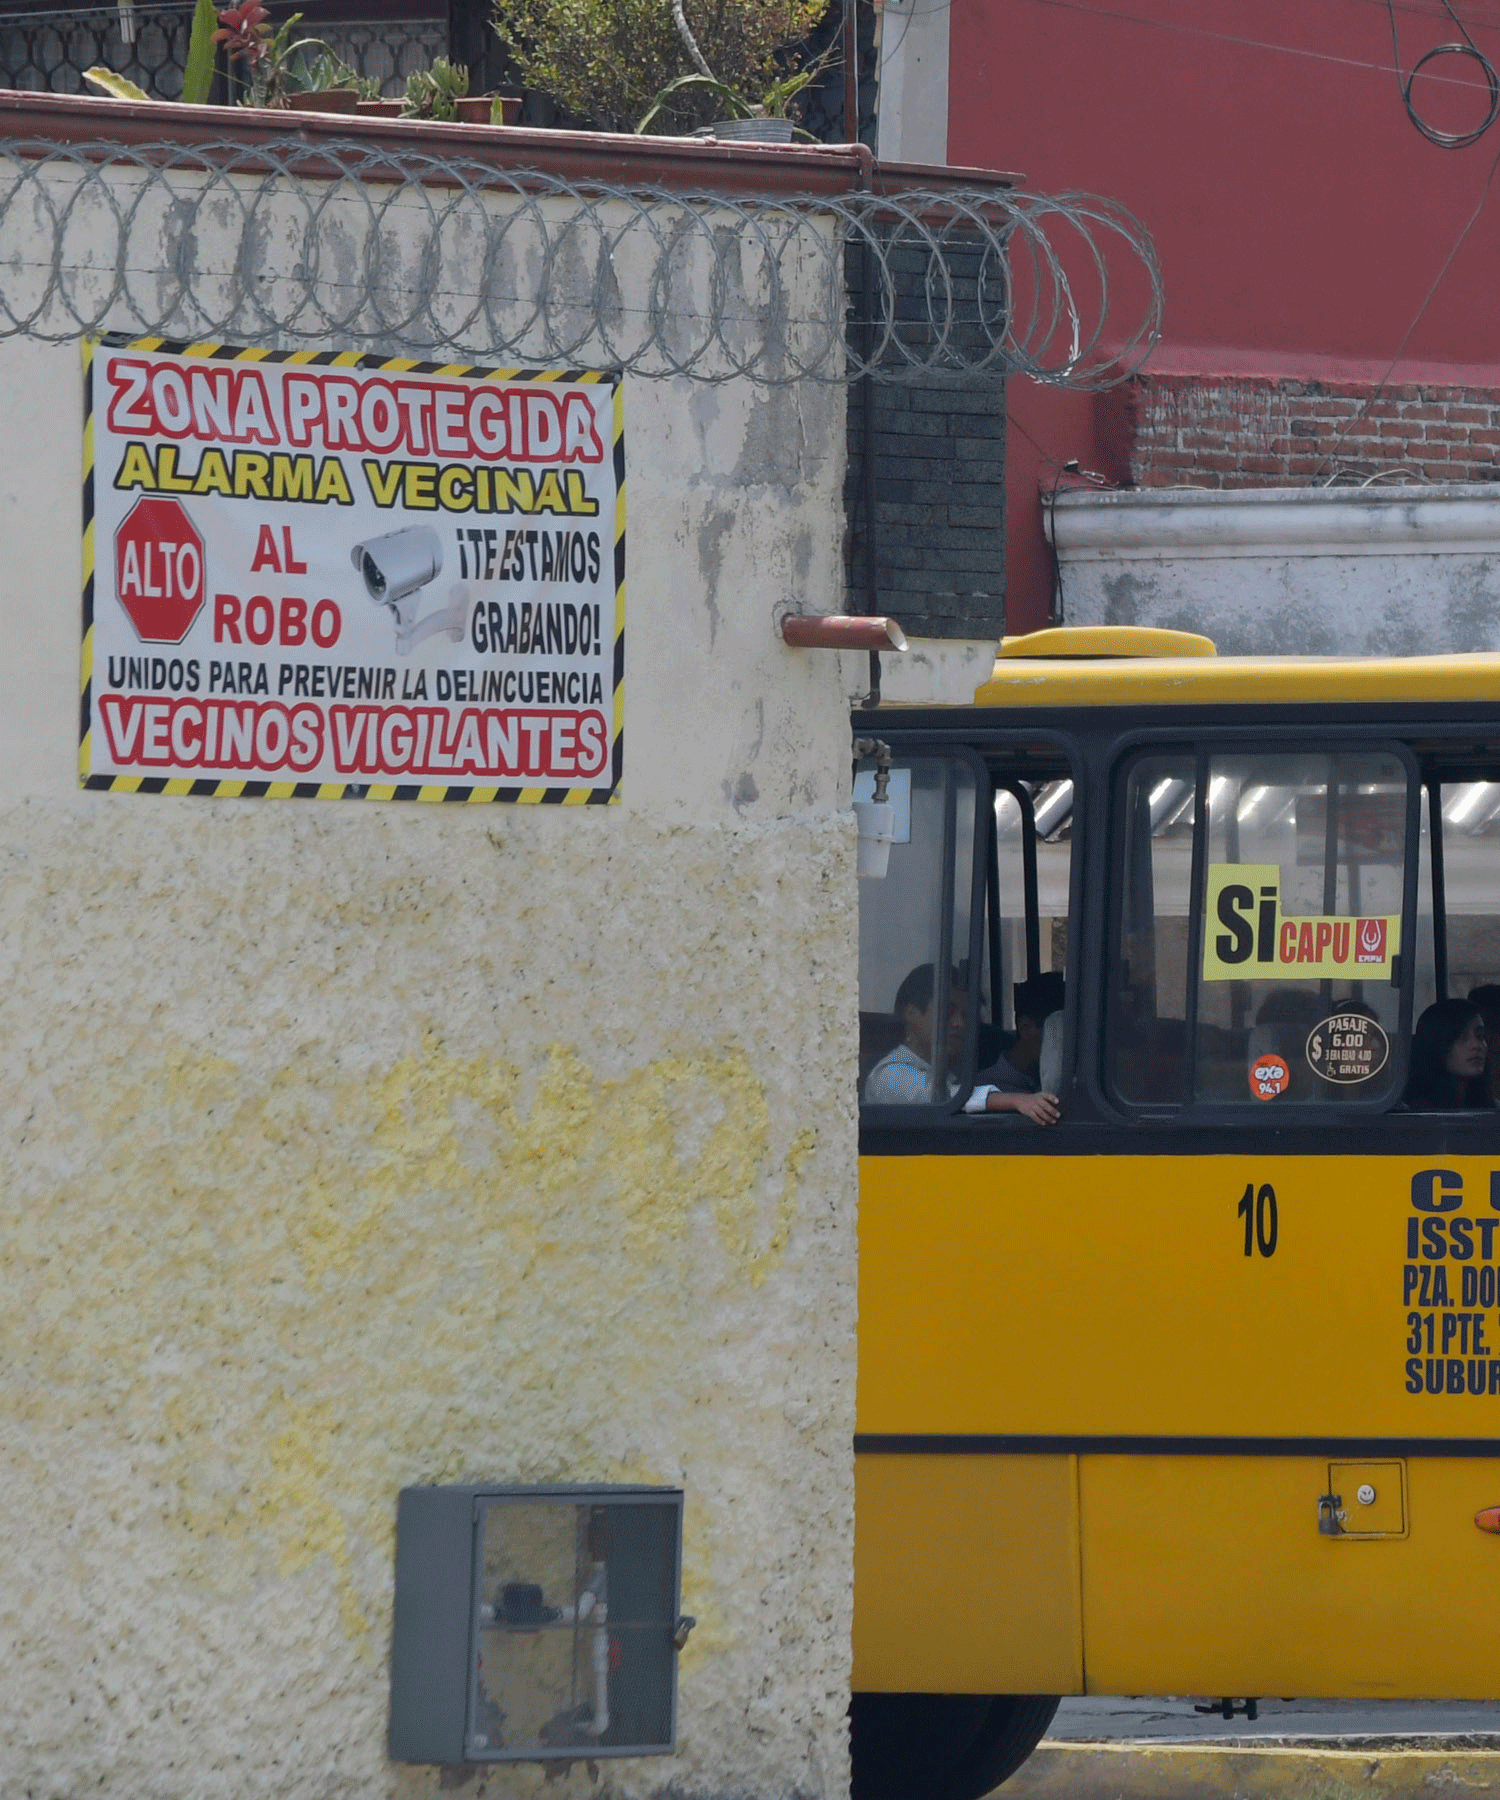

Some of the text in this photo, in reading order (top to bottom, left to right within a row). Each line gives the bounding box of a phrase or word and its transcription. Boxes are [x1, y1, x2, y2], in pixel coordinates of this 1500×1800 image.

[108, 358, 602, 462] ZONA PROTEGIDA
[115, 442, 599, 516] ALARMA VECINAL
[121, 540, 200, 600] ALTO
[251, 524, 308, 575] AL
[457, 529, 601, 584] ¡TE ESTAMOS
[213, 595, 342, 649] ROBO
[471, 602, 601, 656] GRABANDO!
[108, 656, 603, 705] UNIDOS PARA PREVENIR LA DELINCUENCIA
[99, 695, 608, 778] VECINOS VIGILANTES
[1216, 884, 1351, 965] Si CAPU
[1312, 1034, 1364, 1062] $ 6.00
[1328, 1017, 1368, 1034] PASAJE
[1254, 1065, 1284, 1081] exa
[1258, 1082, 1281, 1094] 94.1
[1339, 1065, 1370, 1074] GRATIS
[1411, 1169, 1463, 1213] C
[1237, 1183, 1278, 1258] 10
[1403, 1265, 1455, 1307] PZA.
[1406, 1312, 1435, 1355] 31
[1442, 1313, 1491, 1355] PTE.
